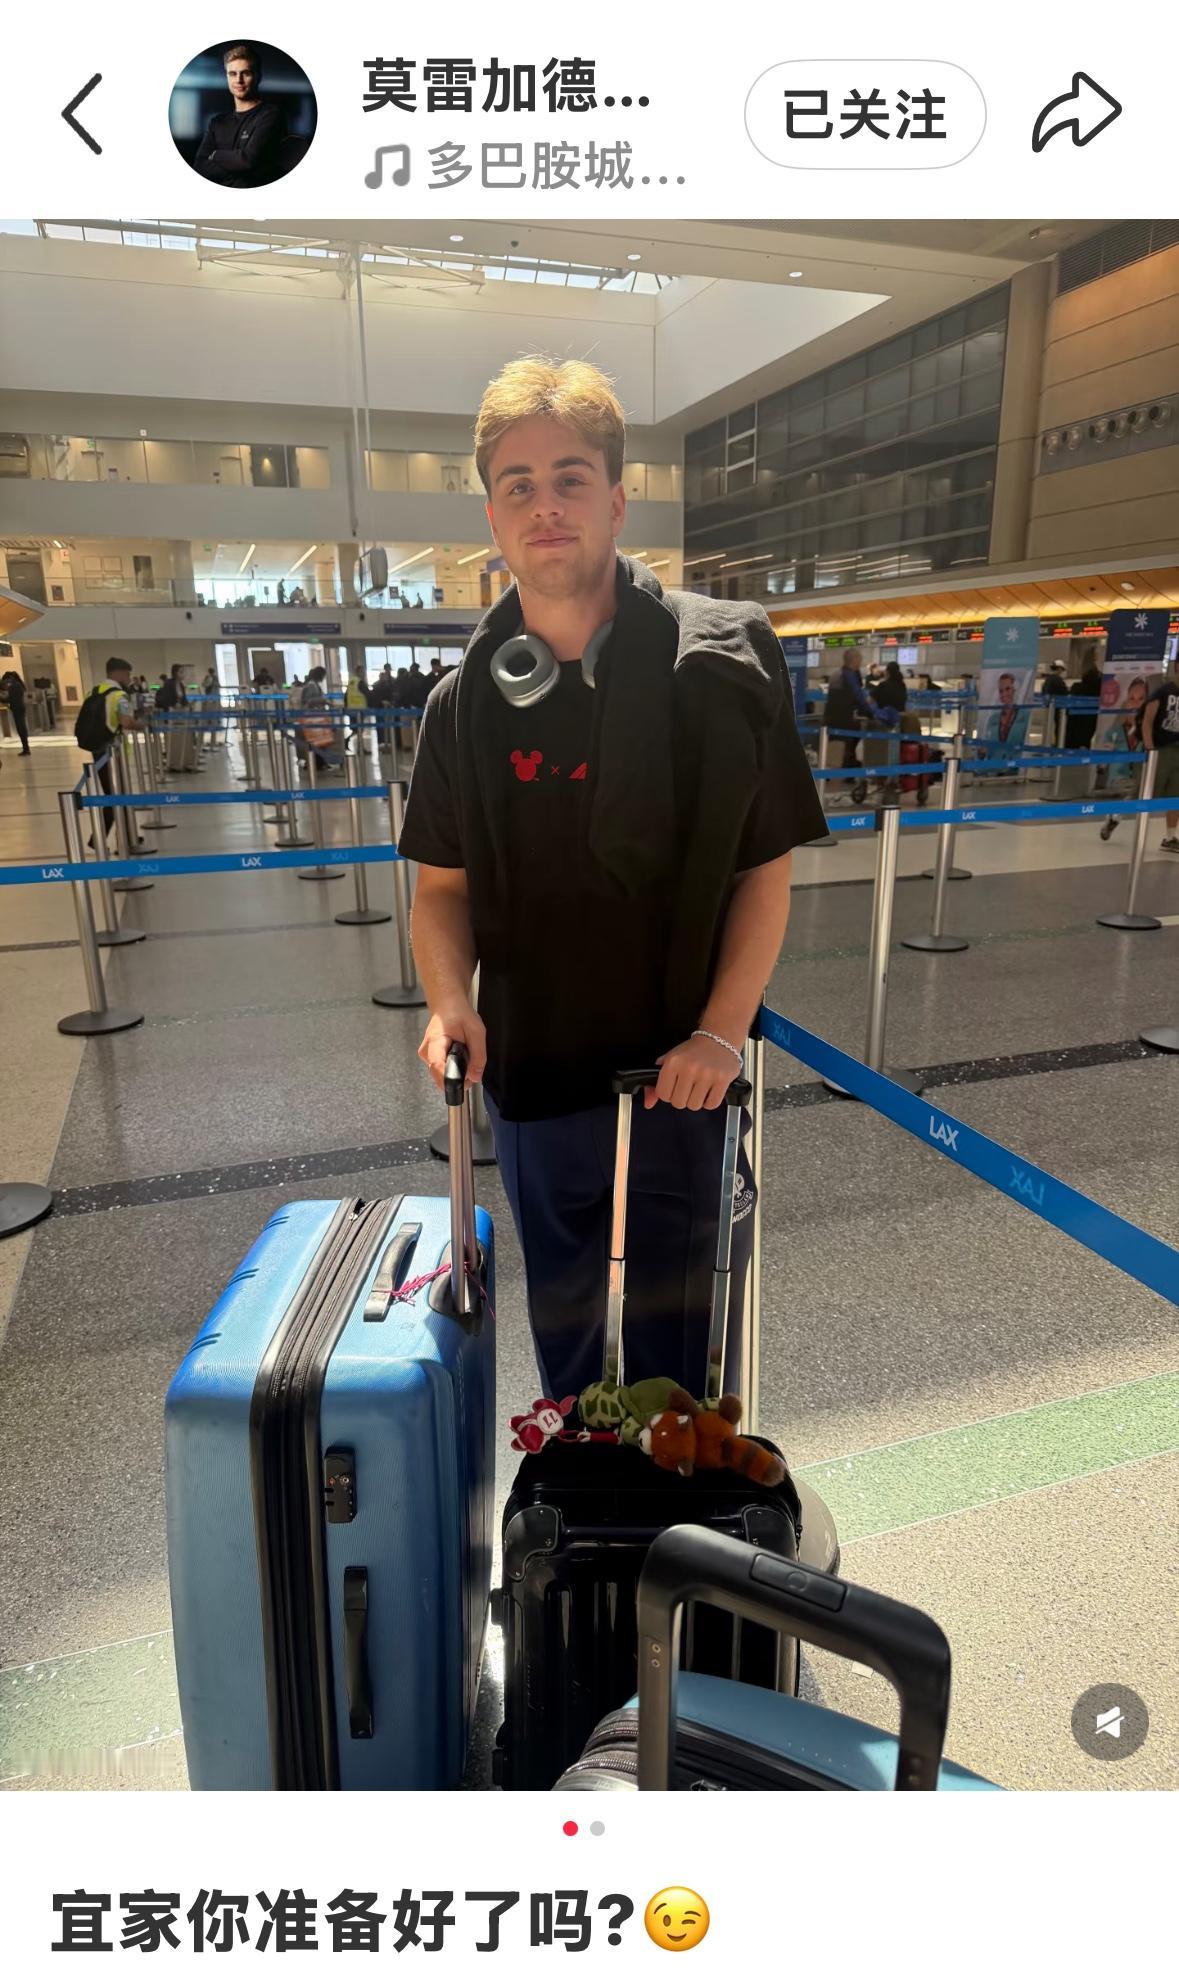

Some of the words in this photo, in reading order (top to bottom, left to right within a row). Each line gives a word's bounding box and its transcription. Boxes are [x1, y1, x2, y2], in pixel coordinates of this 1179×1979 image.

[1081, 805, 1095, 814] LAX
[961, 811, 976, 820] LAX
[851, 817, 866, 826] LAX
[241, 857, 262, 867] LAX
[42, 868, 64, 879] LAX
[929, 1115, 959, 1152] LAX
